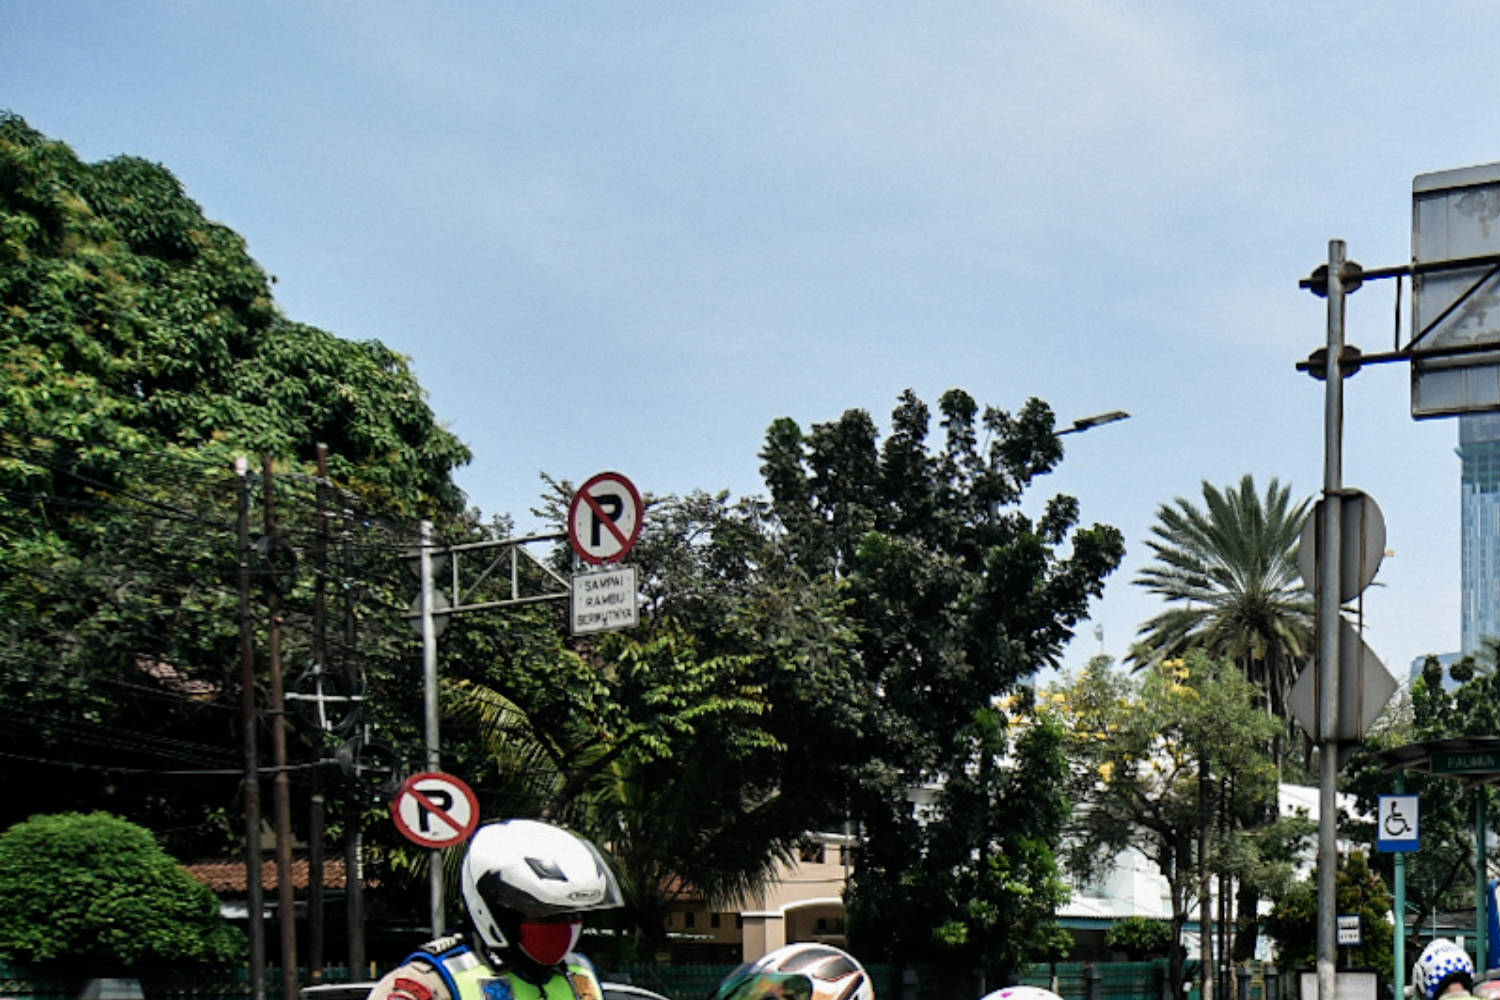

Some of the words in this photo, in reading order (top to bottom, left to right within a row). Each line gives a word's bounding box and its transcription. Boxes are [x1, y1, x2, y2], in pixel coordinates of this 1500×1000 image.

[591, 494, 623, 546] P
[584, 576, 624, 592] SAMPAI
[585, 593, 625, 607] RAMBU
[416, 790, 453, 832] P
